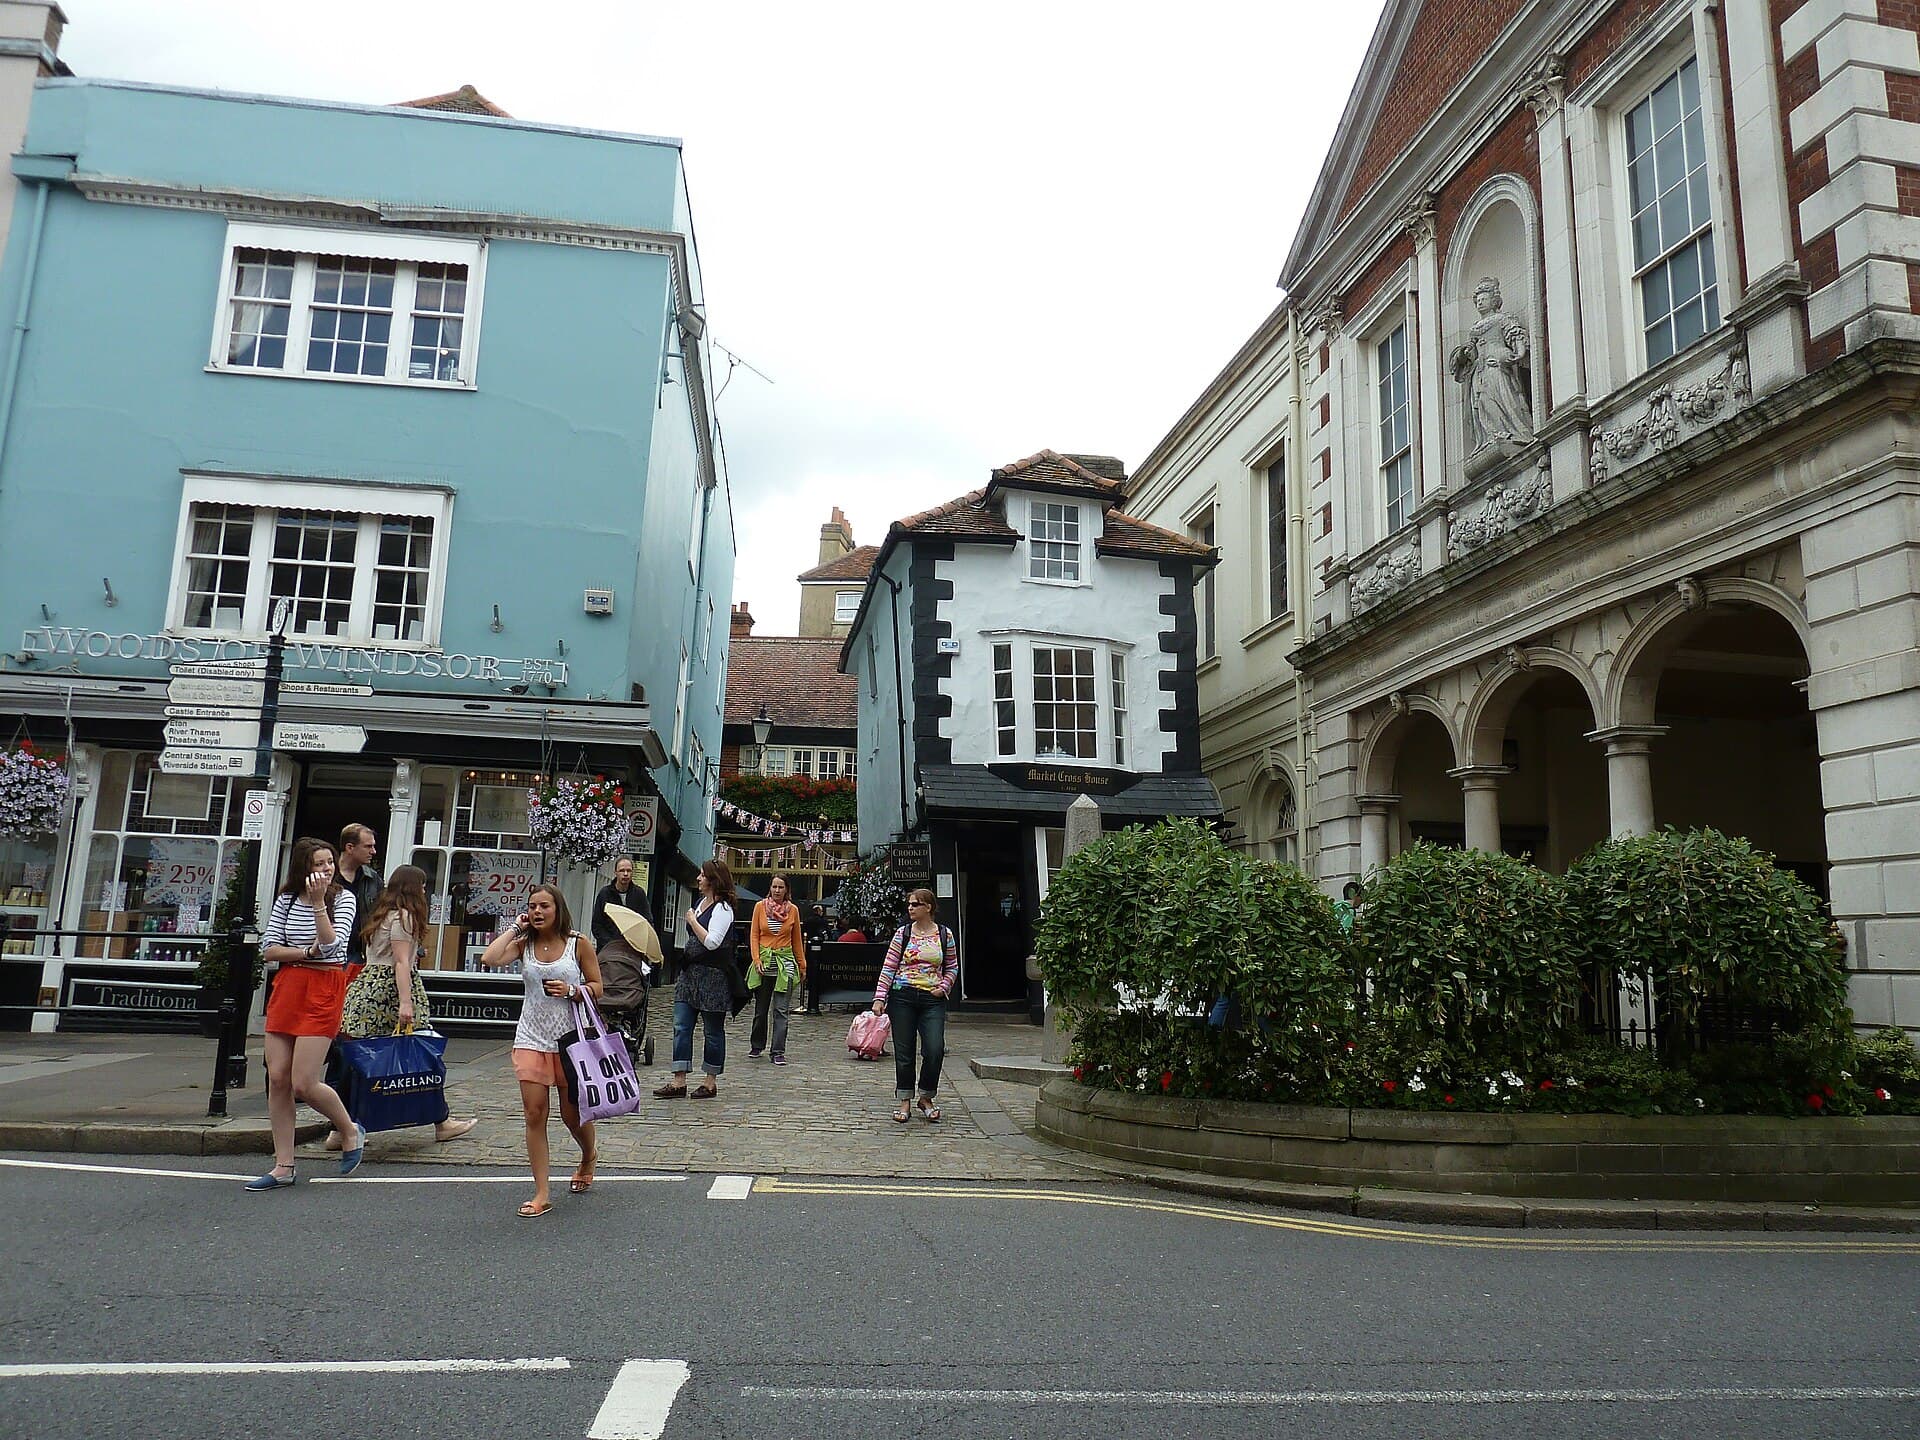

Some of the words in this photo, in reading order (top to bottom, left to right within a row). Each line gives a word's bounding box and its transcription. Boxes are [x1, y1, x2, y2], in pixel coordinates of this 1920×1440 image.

[40, 626, 201, 662] WOODS
[291, 640, 503, 679] WINDSOR
[522, 657, 553, 671] EST
[197, 667, 234, 676] (Disabled
[235, 668, 255, 678] only)
[520, 670, 553, 684] 1770
[313, 685, 359, 694] Restaurants
[169, 707, 194, 715] Castle
[196, 708, 231, 716] Entrance
[168, 736, 198, 744] Theatre
[200, 737, 221, 745] Royal
[280, 732, 299, 741] Long
[301, 732, 319, 740] Walk
[299, 740, 326, 749] Offices
[164, 752, 193, 760] Central
[200, 763, 228, 771] Station
[1028, 769, 1056, 782] Market
[1058, 770, 1082, 784] Cross
[1084, 773, 1110, 786] House
[828, 820, 858, 831] Arms
[893, 848, 928, 857] CROOKED
[489, 857, 539, 869] YARDLEY
[898, 857, 922, 866] HOUSE
[169, 864, 216, 885] 25%
[893, 870, 928, 879] WINDSOR
[488, 874, 537, 894] 25%
[181, 886, 203, 895] OFF
[500, 895, 523, 905] OFF
[94, 986, 198, 1009] Traditiona
[430, 998, 510, 1019] erfumers
[383, 1074, 442, 1090] LAKELAND
